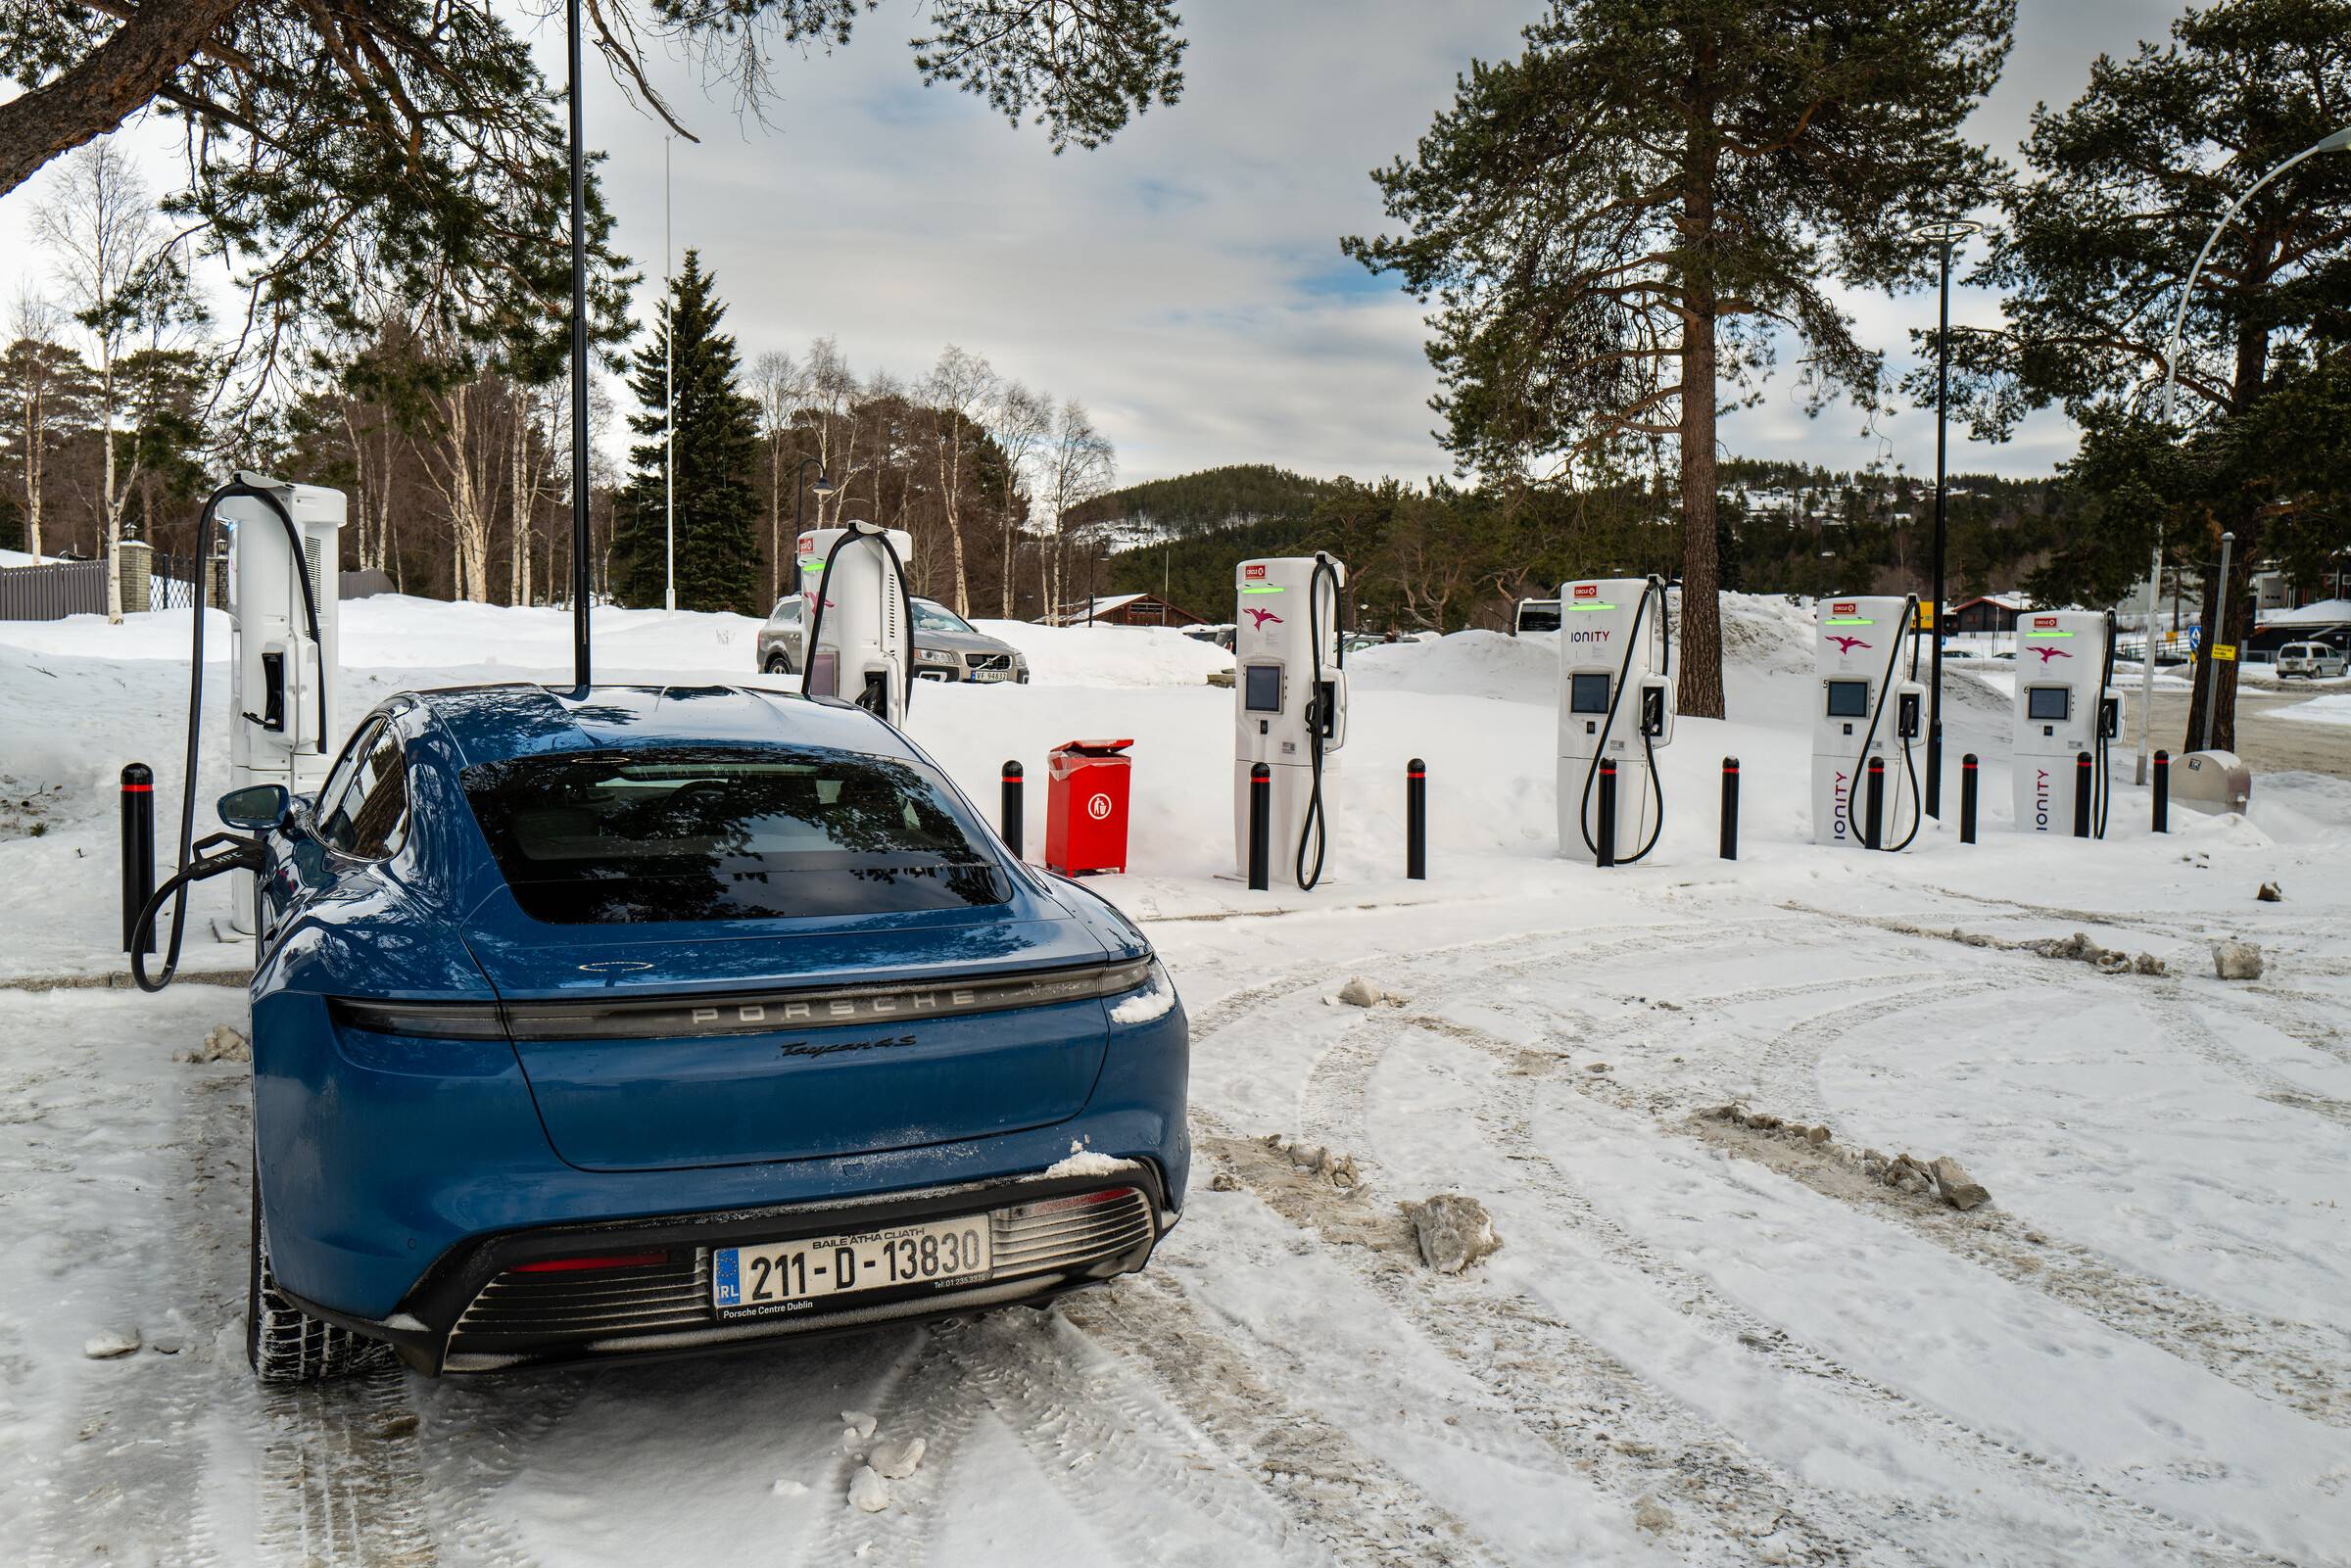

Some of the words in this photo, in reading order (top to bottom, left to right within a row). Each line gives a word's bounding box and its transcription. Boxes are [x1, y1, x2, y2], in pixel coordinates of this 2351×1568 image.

[1570, 631, 1610, 643] IONITY
[1834, 771, 1847, 840] IONITY
[2036, 769, 2049, 832] IONITY
[214, 851, 243, 863] HPC
[692, 989, 975, 1024] PORSCHE
[781, 1041, 873, 1059] Taycan
[812, 1237, 848, 1250] BAILE
[884, 1227, 925, 1240] CLIATH
[750, 1229, 980, 1301] 211-D-13830
[723, 1307, 757, 1319] Porsche
[758, 1305, 786, 1315] Centre
[787, 1300, 813, 1311] Dublin
